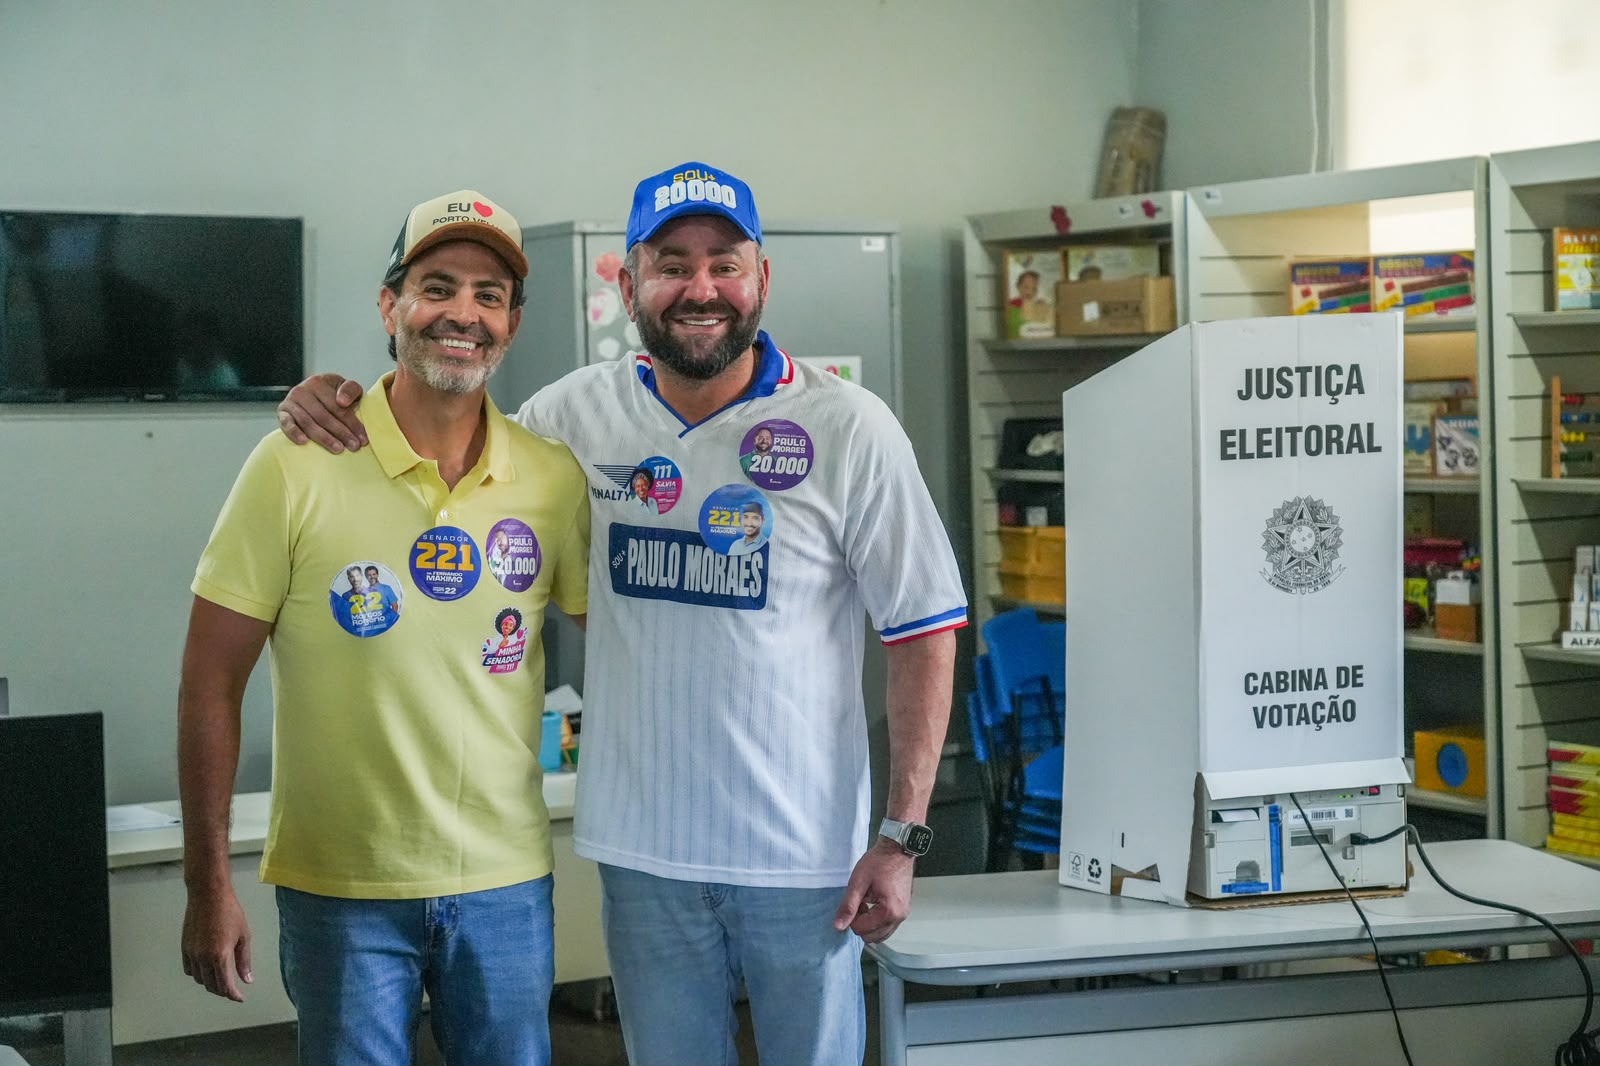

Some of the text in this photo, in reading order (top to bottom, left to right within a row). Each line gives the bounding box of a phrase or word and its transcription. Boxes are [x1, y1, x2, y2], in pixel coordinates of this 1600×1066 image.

[655, 180, 737, 212] 20000
[448, 203, 470, 212] EU
[433, 216, 470, 225] PORTO
[1237, 364, 1365, 405] JUSTIÇA
[770, 446, 806, 454] MORAES
[774, 437, 806, 447] PAULO
[1220, 422, 1382, 461] ELEITORAL
[654, 465, 672, 478] 111
[749, 454, 808, 476] 20.000
[708, 509, 741, 527] 221
[509, 537, 533, 546] PAULO
[509, 546, 533, 554] MORAES
[416, 541, 475, 571] 221
[495, 557, 536, 576] 20.000
[627, 538, 681, 589] PAULO
[684, 544, 763, 598] MORAES
[445, 587, 457, 595] 22
[349, 591, 384, 615] 22
[485, 652, 522, 665] SENADORA
[498, 644, 522, 656] MINHA
[1244, 665, 1364, 695] CABINA DE
[1252, 694, 1357, 731] VOTAÇÃO
